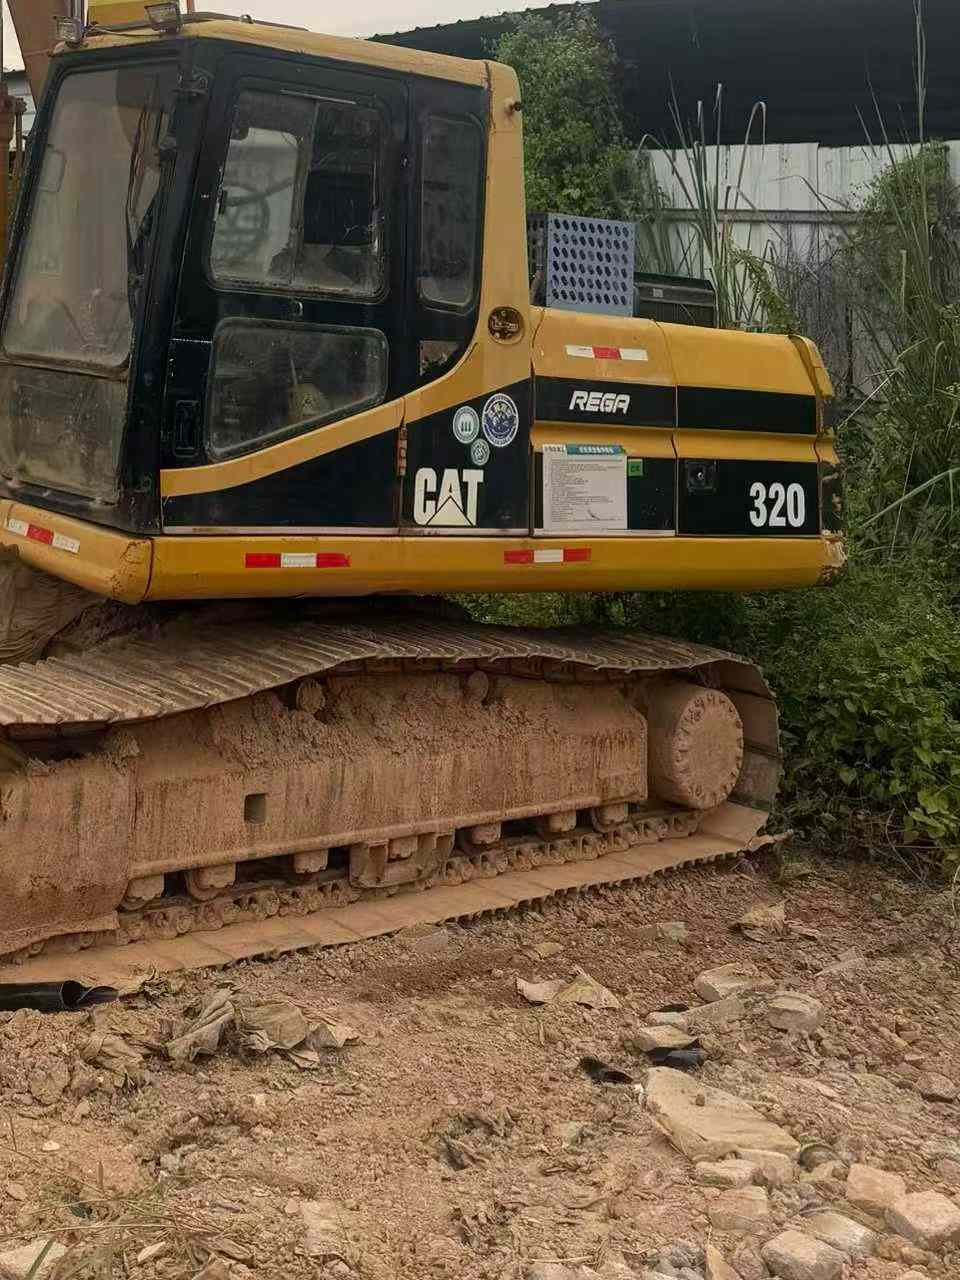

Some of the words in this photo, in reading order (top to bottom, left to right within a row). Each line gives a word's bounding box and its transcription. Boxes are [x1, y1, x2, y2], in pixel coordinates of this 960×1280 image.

[569, 390, 630, 414] REGA
[414, 467, 484, 526] CAT
[749, 482, 806, 528] 320
